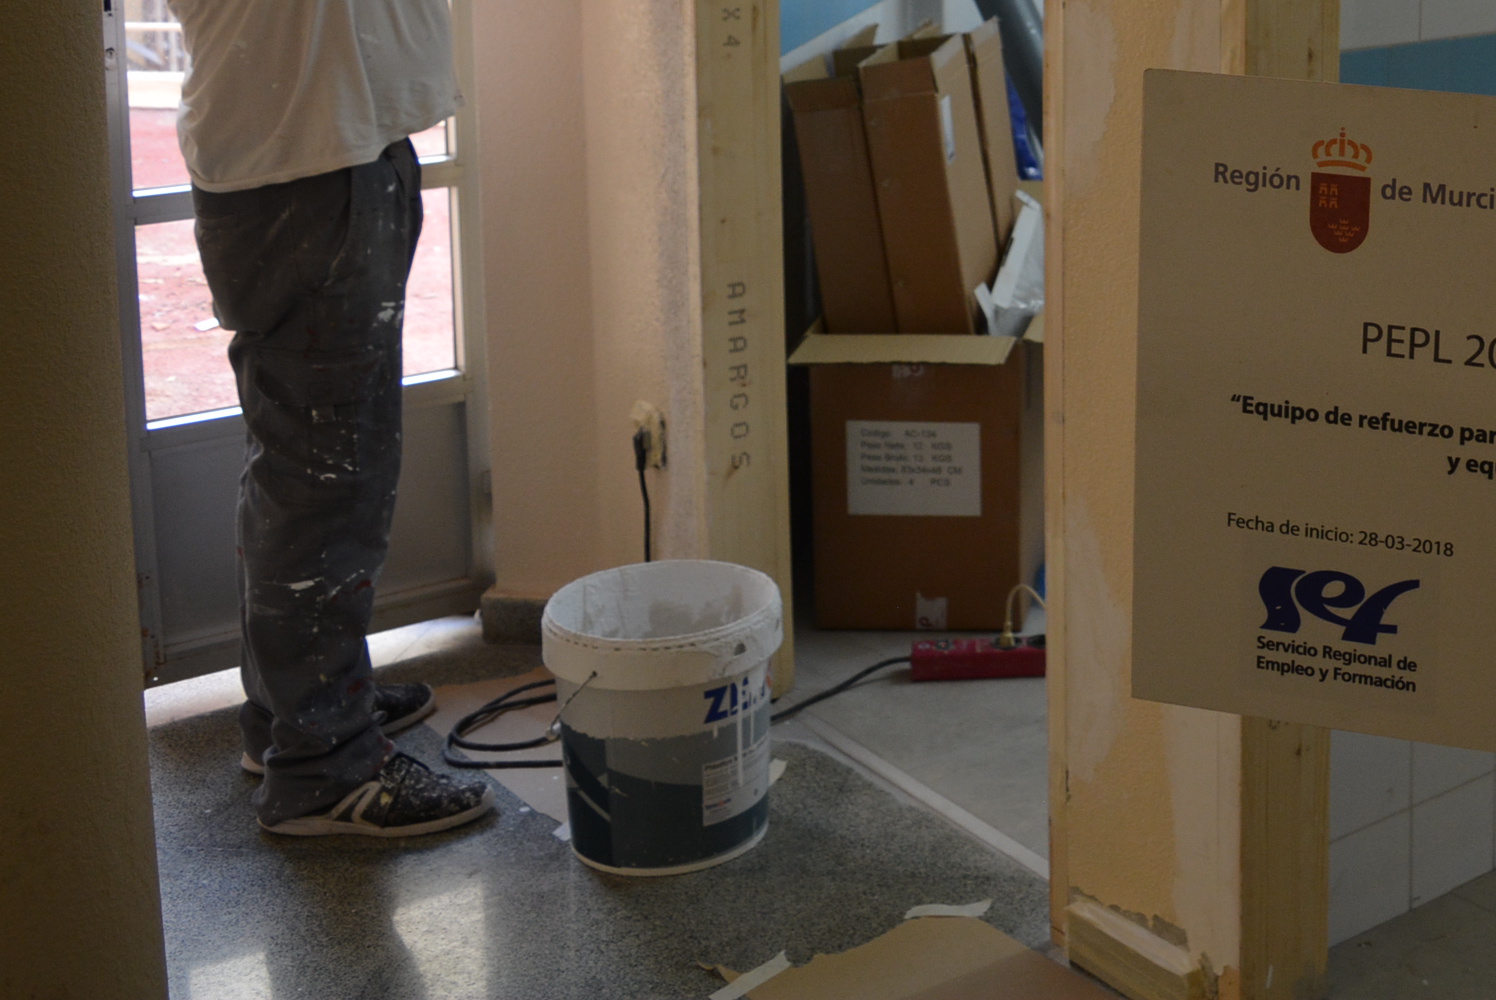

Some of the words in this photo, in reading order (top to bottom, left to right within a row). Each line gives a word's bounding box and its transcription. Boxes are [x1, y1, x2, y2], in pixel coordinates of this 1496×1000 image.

[1213, 162, 1301, 193] Región
[1380, 177, 1413, 203] de
[1361, 321, 1453, 365] PEPL
[727, 282, 750, 468] AMARGOS
[1324, 405, 1353, 427] de
[1358, 411, 1455, 440] refuerzo
[1446, 455, 1462, 476] y
[1227, 511, 1275, 534] Fecha
[1278, 519, 1301, 537] de
[1304, 522, 1354, 544] inicio:
[1357, 530, 1454, 558] 28-03-2018
[1256, 635, 1319, 658] Servicio
[1322, 645, 1392, 666] Regional
[1397, 656, 1418, 672] de
[1256, 656, 1315, 676] Empleo
[1318, 668, 1329, 682] y
[1333, 667, 1417, 692] Formación
